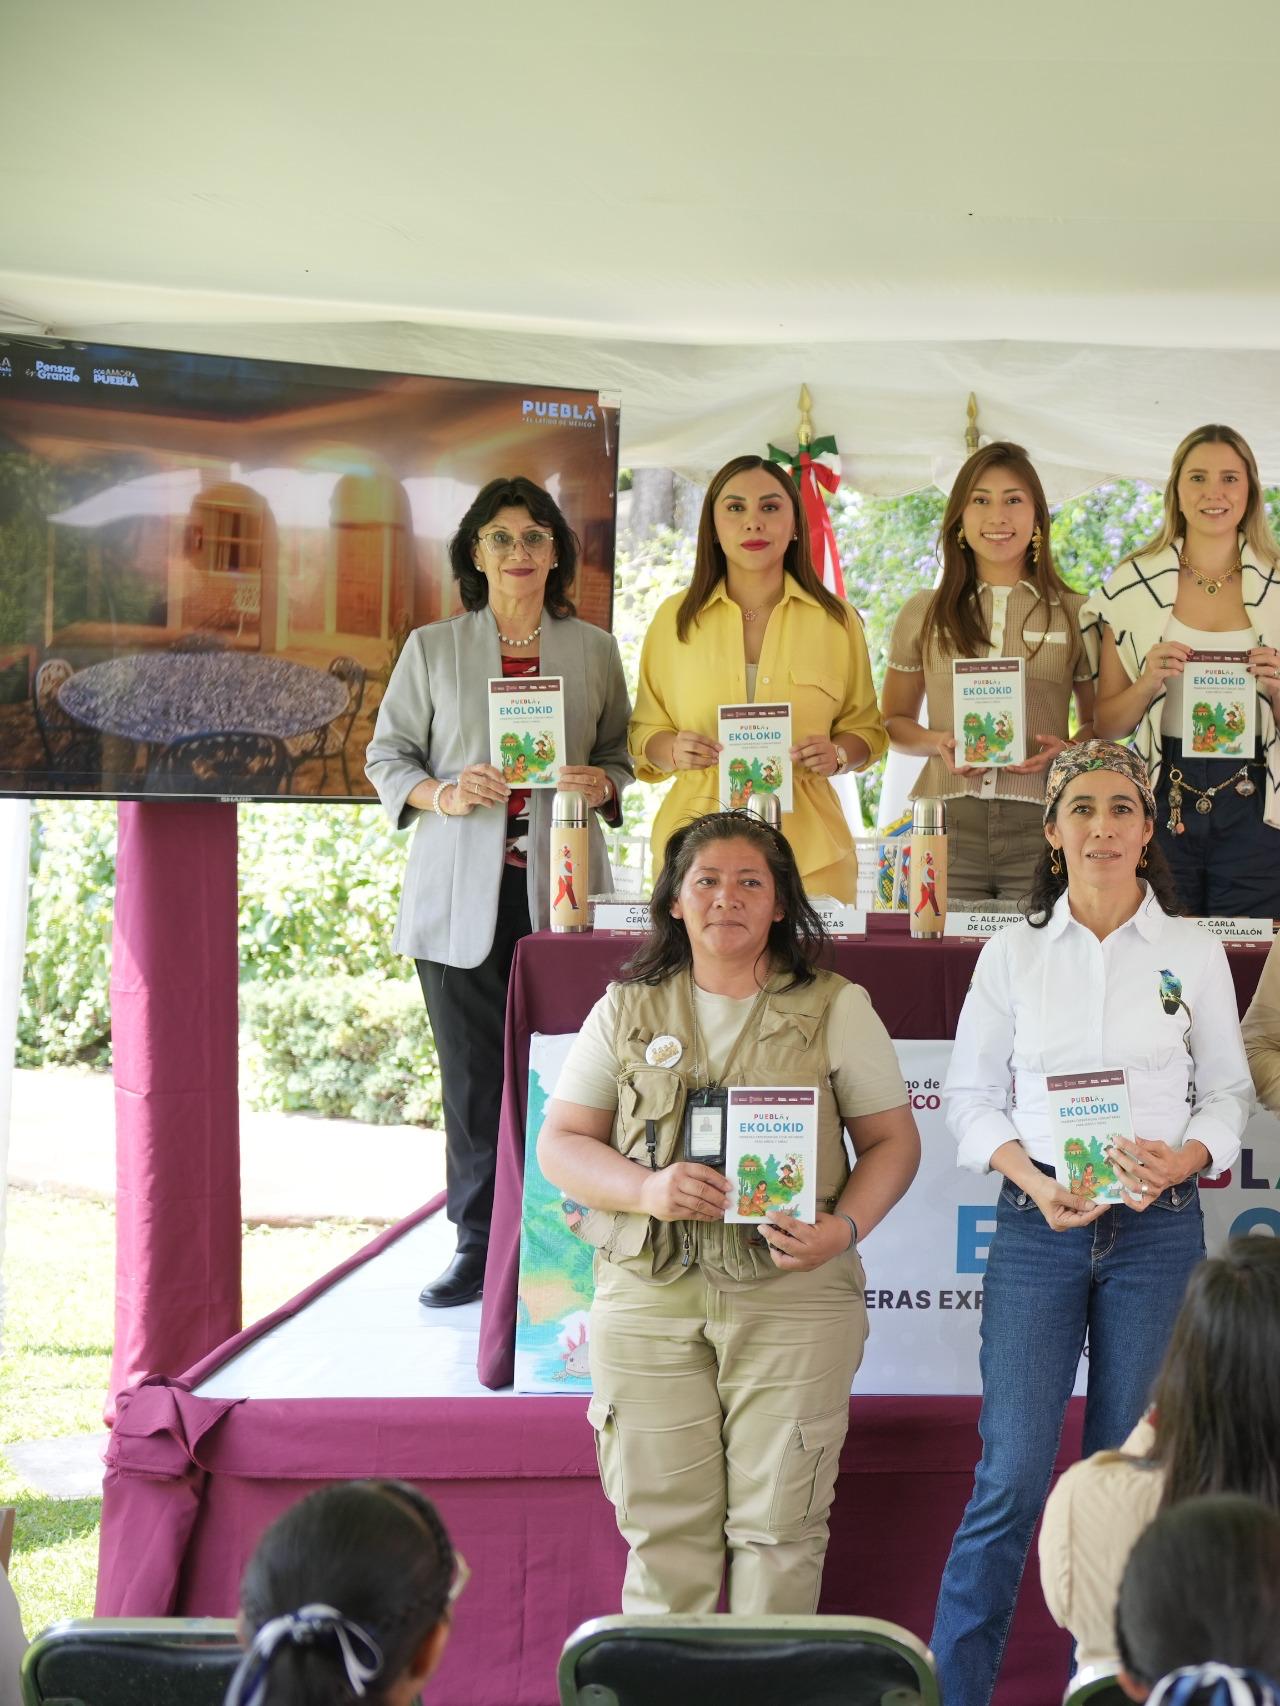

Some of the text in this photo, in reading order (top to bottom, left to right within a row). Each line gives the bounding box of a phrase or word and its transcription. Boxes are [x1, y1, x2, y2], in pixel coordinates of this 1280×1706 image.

[36, 361, 75, 375] Pensar
[37, 371, 80, 382] Grande
[93, 374, 139, 388] PUEBLA
[522, 400, 596, 421] PUEBLA
[1193, 677, 1246, 685] EKOLOKID
[963, 686, 1012, 696] EKOLOKID
[500, 706, 553, 715] EKOLOKID
[729, 732, 781, 741] EKOLOKID
[1225, 927, 1262, 936] VILLALÓN
[924, 1078, 940, 1089] de
[1071, 1096, 1100, 1104] PUEBLA
[1060, 1103, 1119, 1117] EKOLOKID
[739, 1122, 804, 1132] EKOLOKID
